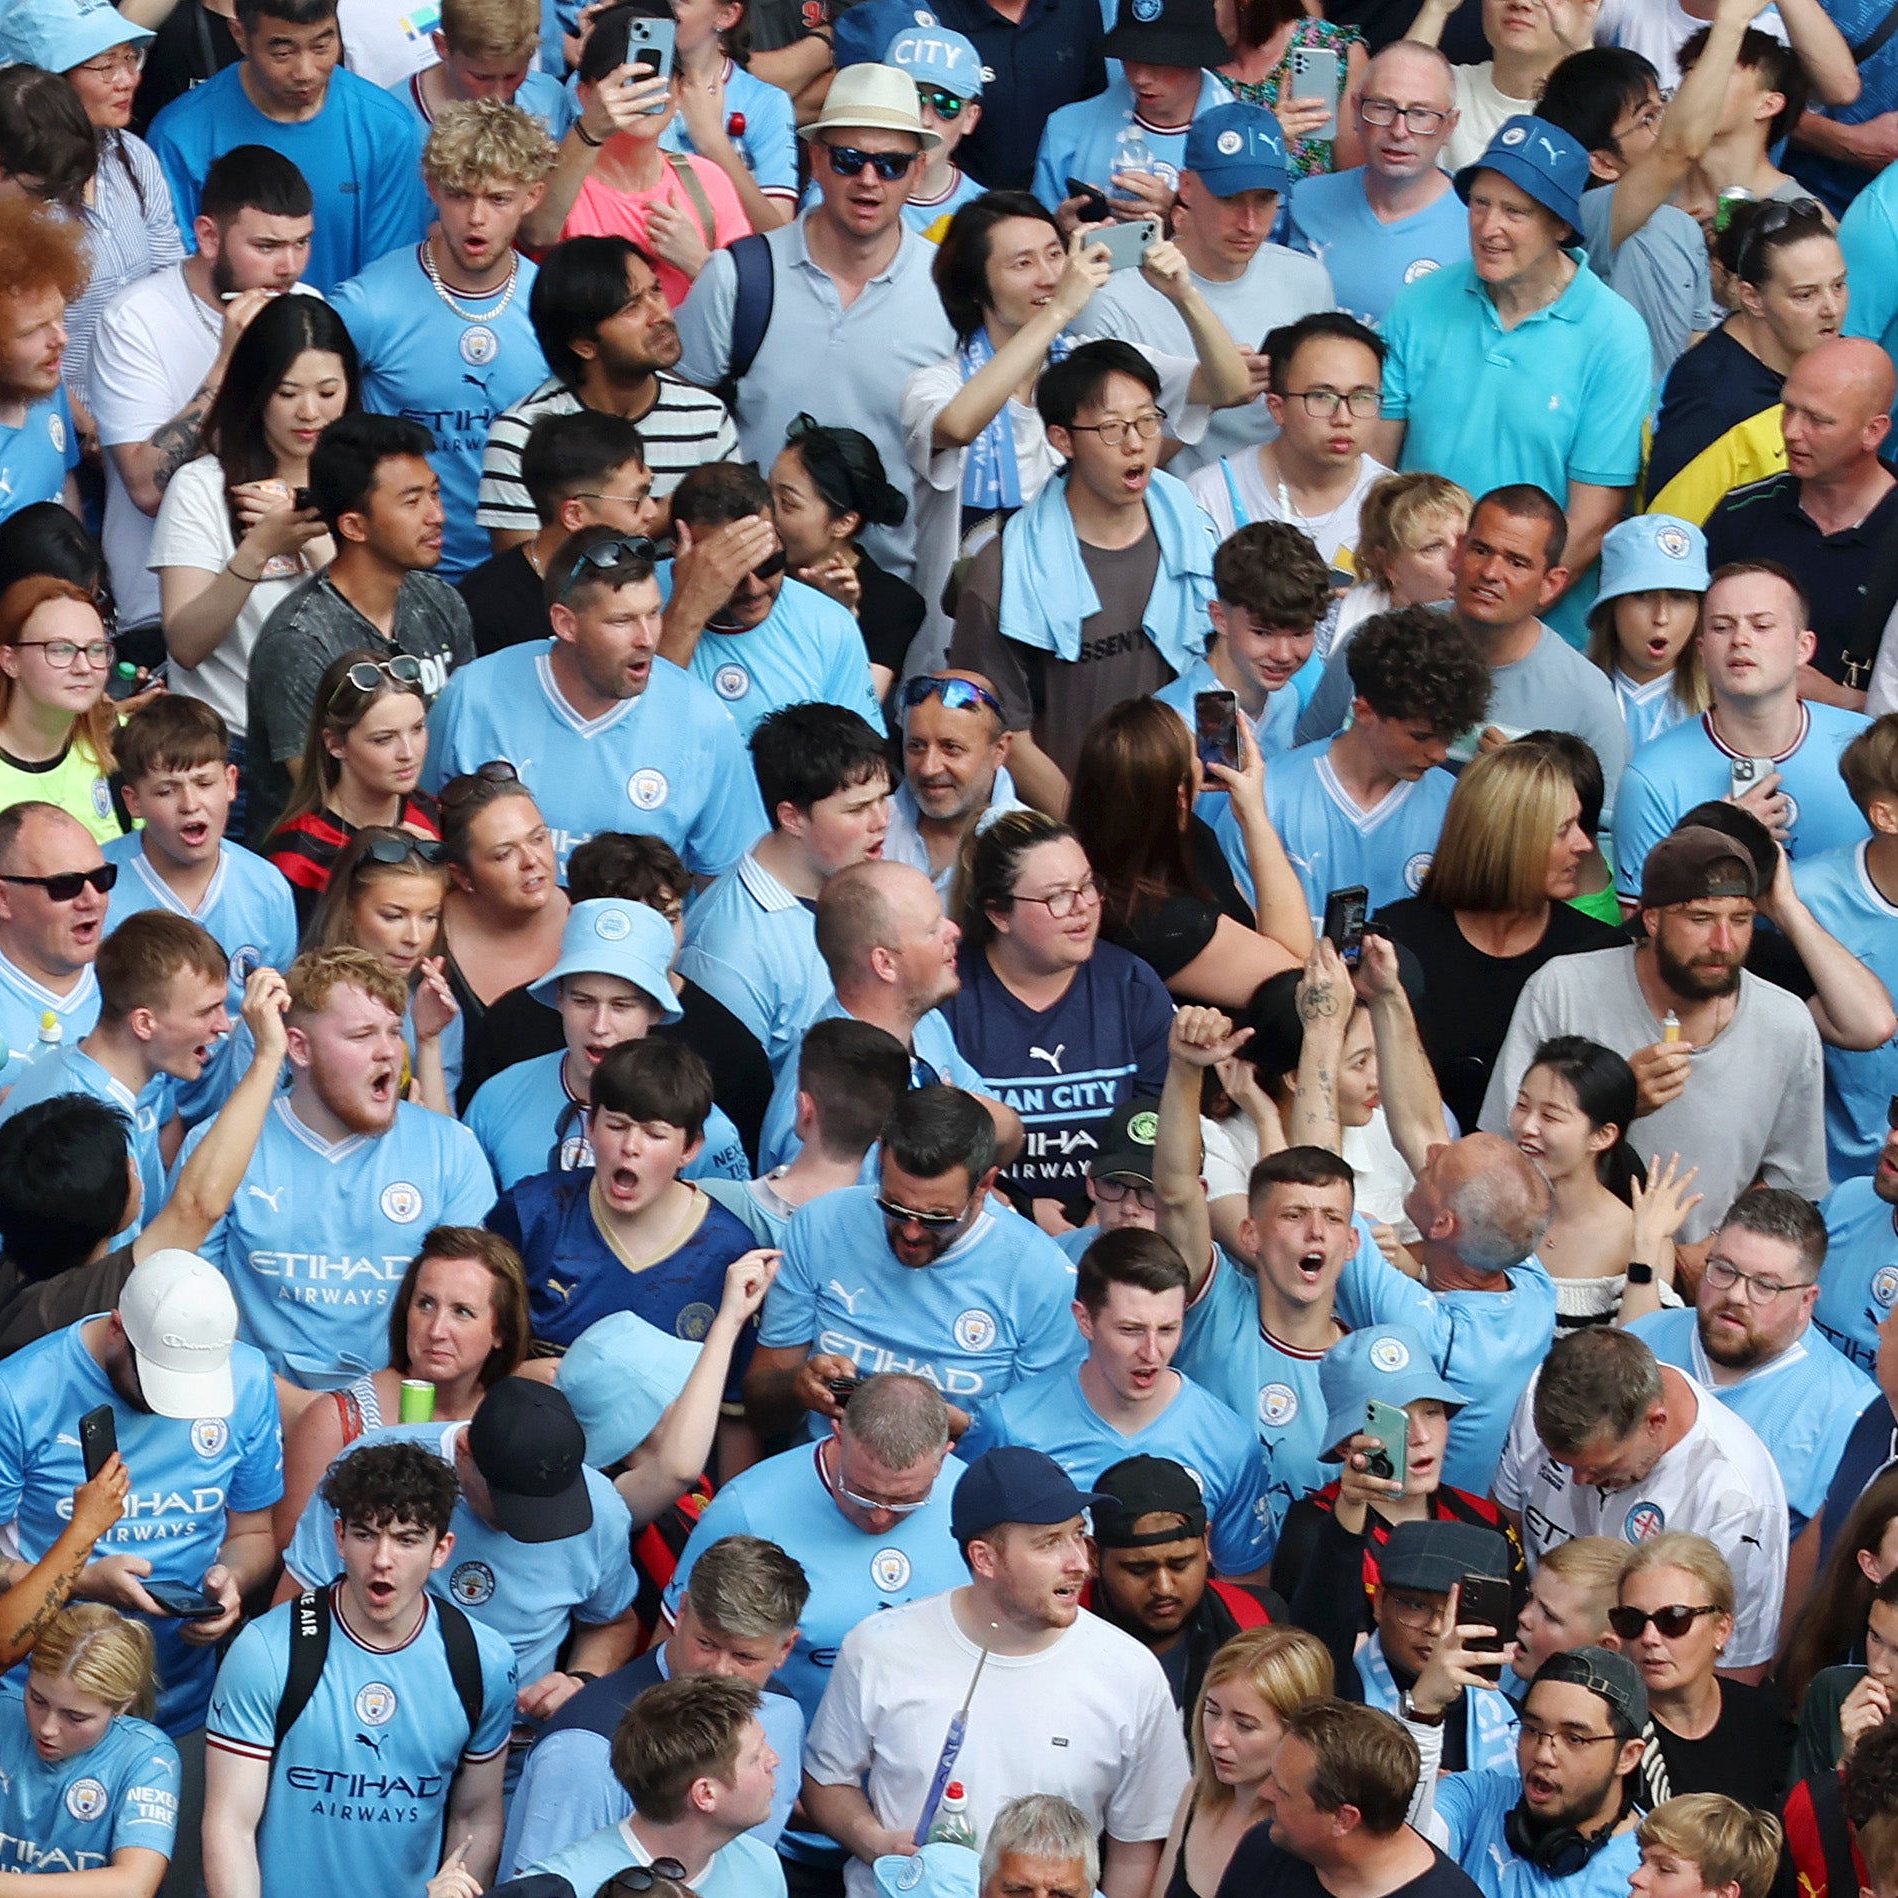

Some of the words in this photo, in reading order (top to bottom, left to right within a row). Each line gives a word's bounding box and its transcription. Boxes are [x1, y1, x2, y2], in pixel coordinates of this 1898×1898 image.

[894, 38, 961, 68] CITY
[1051, 1080, 1117, 1107] CITY
[278, 1287, 388, 1306] AIRWAYS
[300, 1608, 317, 1636] AIR
[285, 1767, 444, 1799] ETIHAD
[309, 1802, 419, 1823] AIRWAYS
